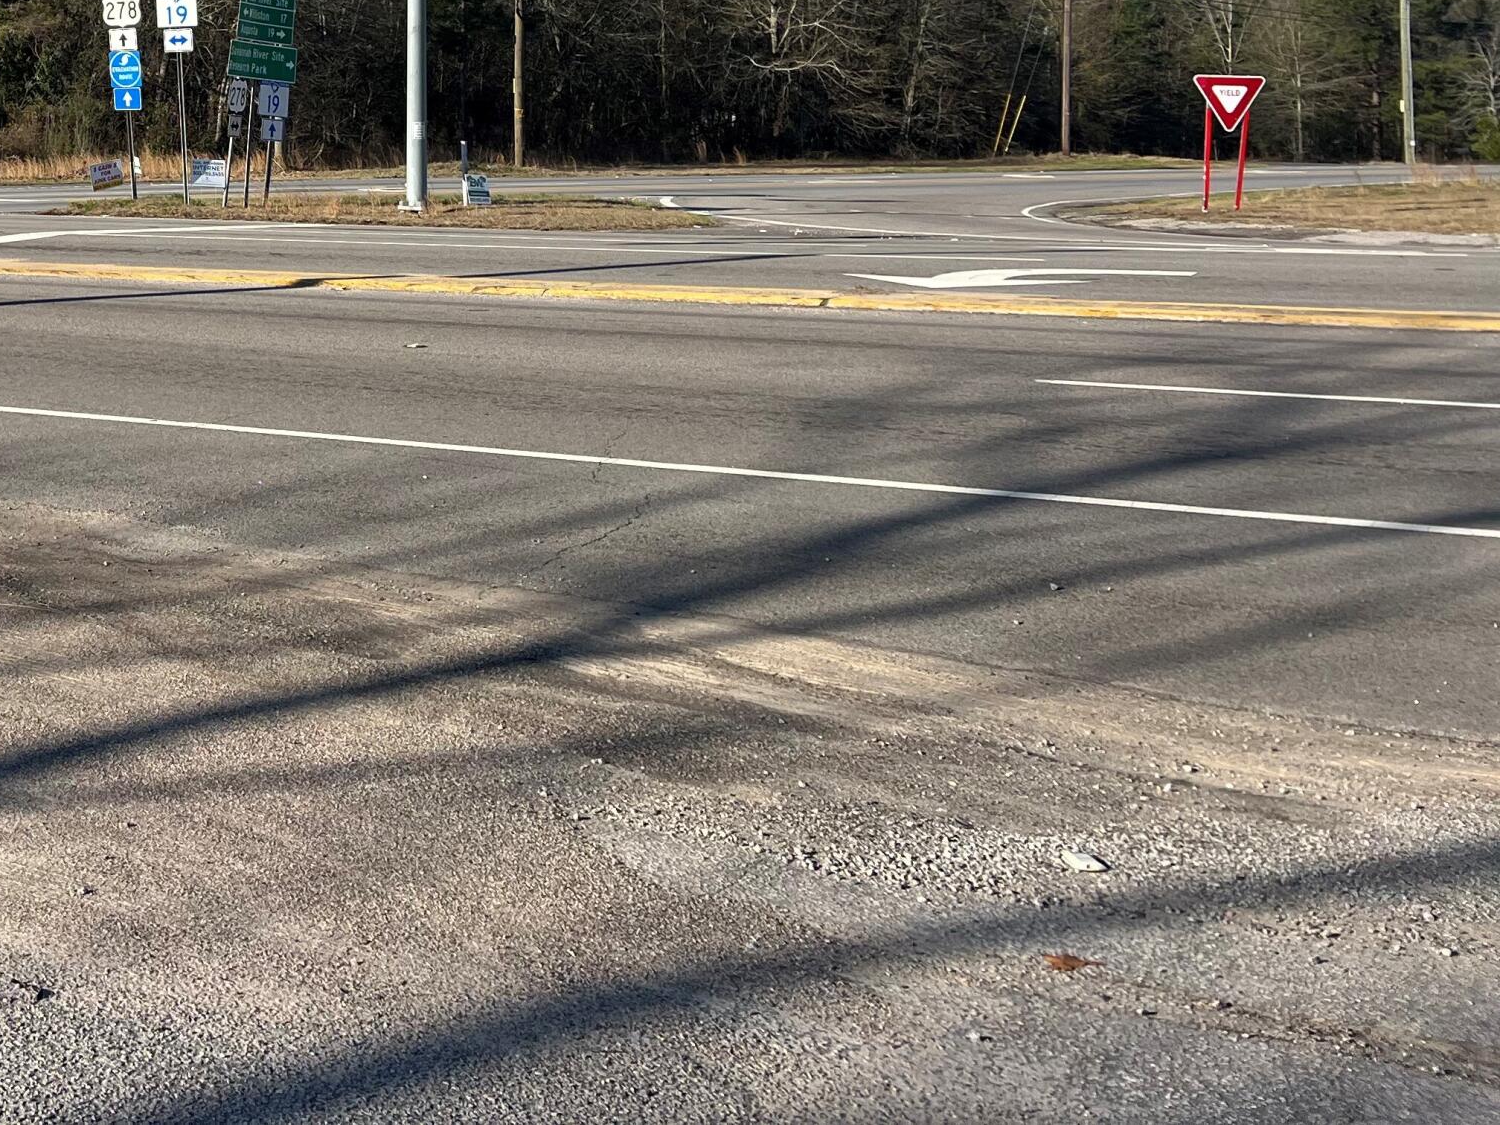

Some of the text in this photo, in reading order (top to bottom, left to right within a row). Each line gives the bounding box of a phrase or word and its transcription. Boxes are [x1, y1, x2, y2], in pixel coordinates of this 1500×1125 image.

[106, 1, 137, 20] 278
[166, 5, 188, 25] 19
[272, 51, 285, 62] Site
[251, 63, 267, 75] Park
[230, 87, 245, 106] 278
[1219, 89, 1241, 97] YIELD
[267, 95, 280, 114] 19
[193, 164, 224, 172] INTERNET
